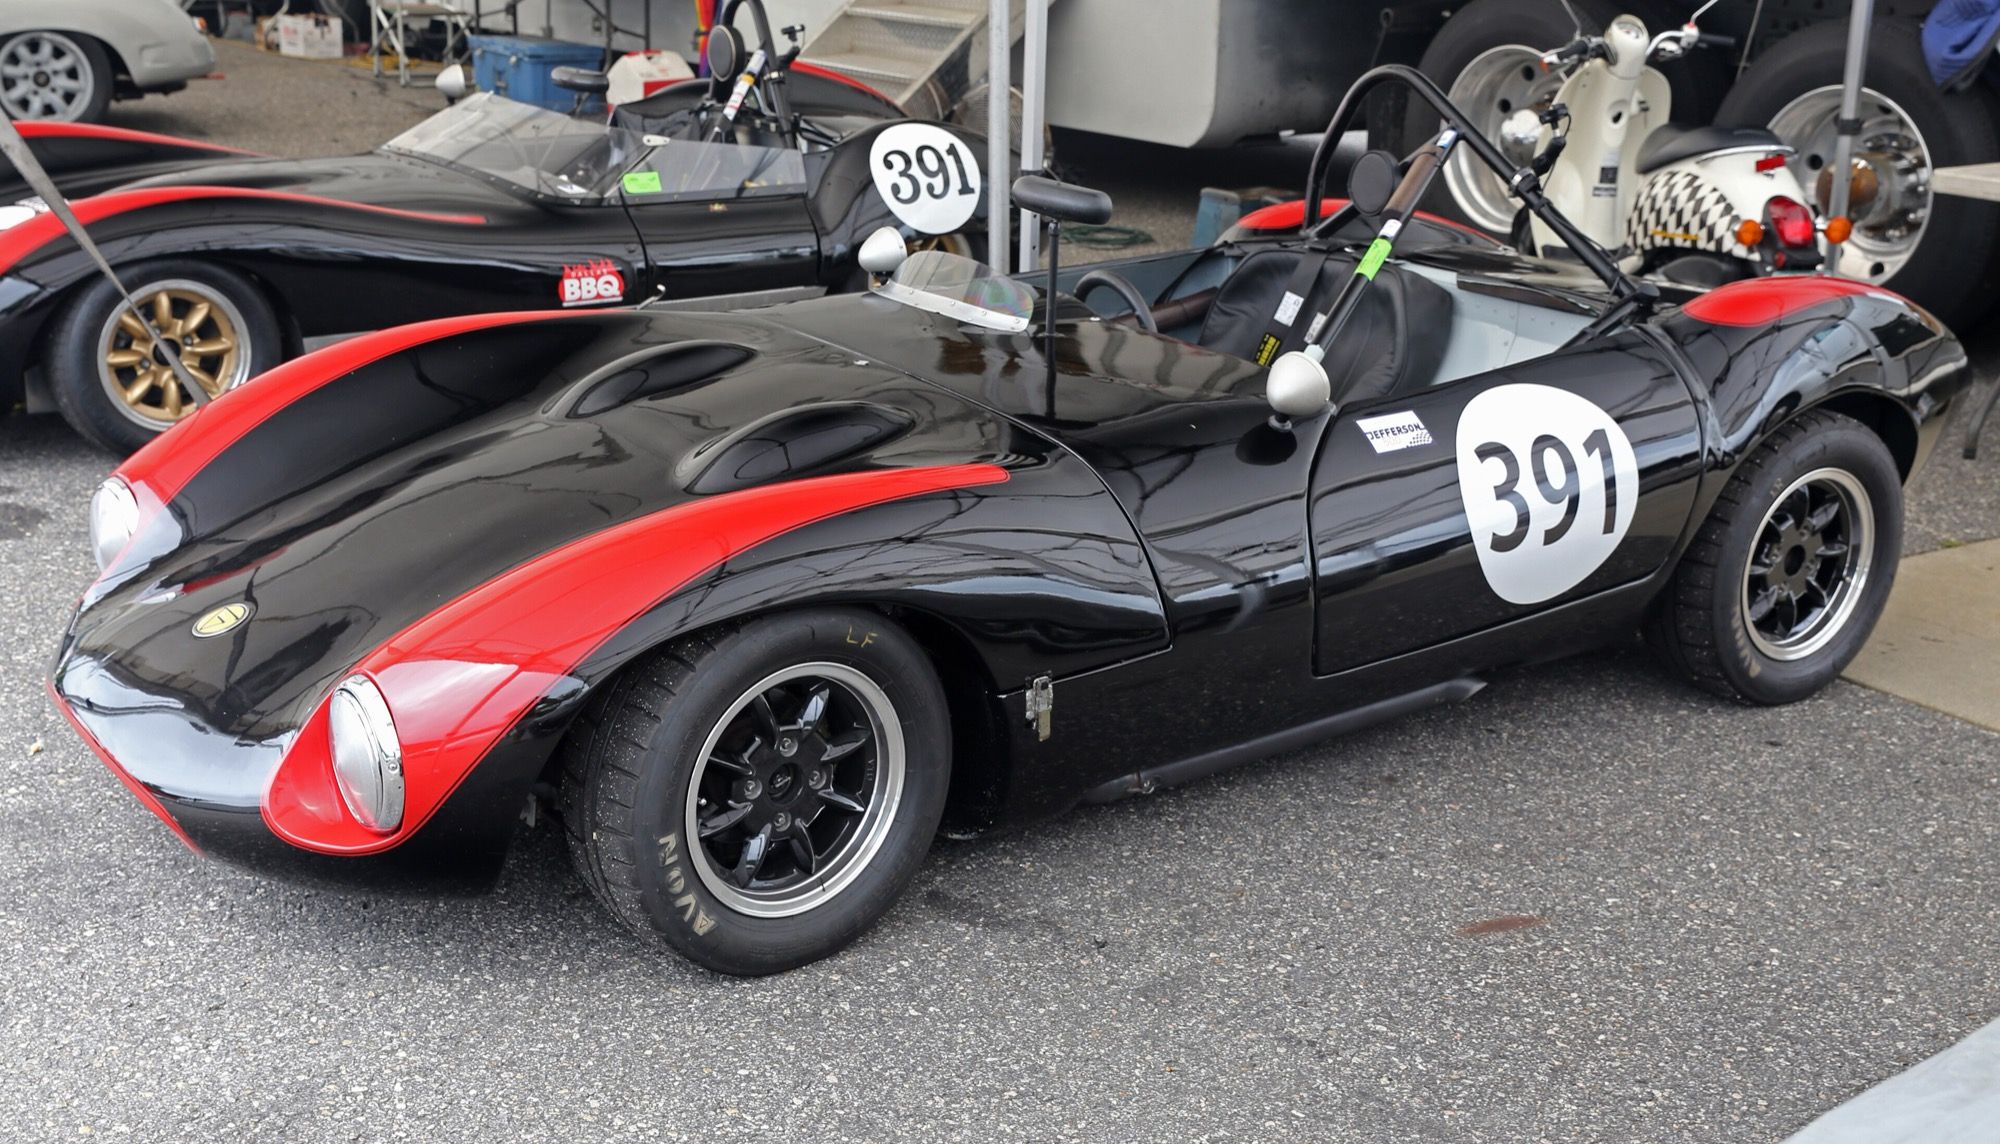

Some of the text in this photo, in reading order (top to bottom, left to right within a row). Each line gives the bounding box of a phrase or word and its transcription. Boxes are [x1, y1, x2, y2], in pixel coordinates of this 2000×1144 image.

[883, 143, 975, 205] 391
[563, 274, 620, 302] BBQ
[1366, 423, 1422, 440] JEFFERSON
[1474, 428, 1617, 553] 391
[846, 623, 878, 648] LF
[658, 833, 717, 936] AVON
